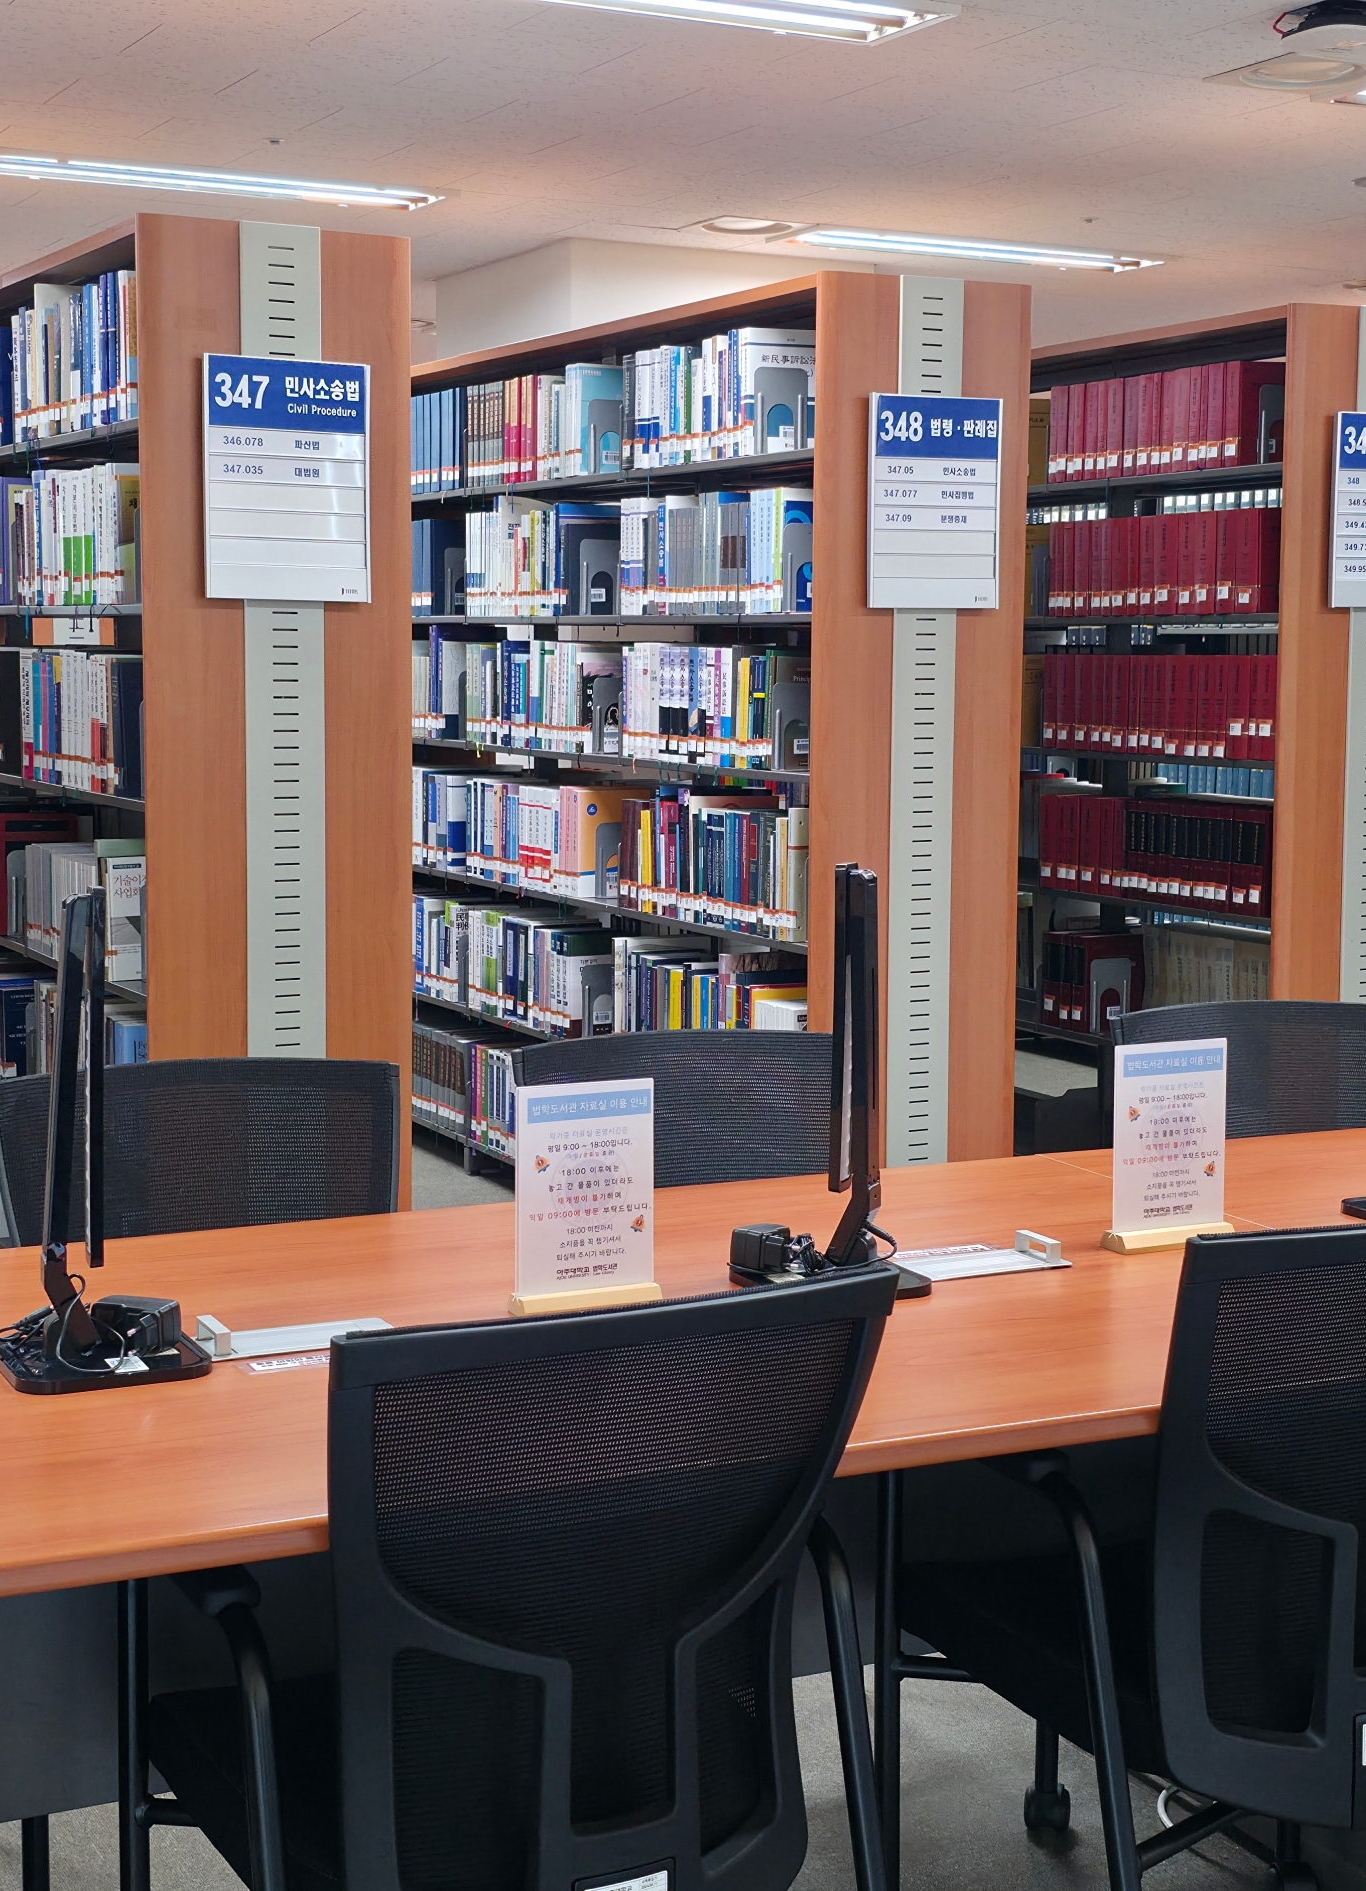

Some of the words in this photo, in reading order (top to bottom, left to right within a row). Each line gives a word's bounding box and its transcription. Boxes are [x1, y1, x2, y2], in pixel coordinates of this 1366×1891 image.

[214, 372, 270, 410] 347
[285, 376, 360, 402] 민사소송법
[288, 403, 308, 415] Civil
[312, 405, 357, 418] Procedure
[880, 410, 923, 442] 348
[223, 435, 264, 447] 346.078
[294, 439, 320, 450] 파산법
[223, 464, 264, 475] 347.035
[294, 467, 320, 478] 대법원
[887, 466, 914, 475] 347.05
[943, 467, 976, 477] 민사소송법
[1347, 477, 1360, 485] 348
[884, 489, 918, 498] 347.077
[885, 514, 912, 523] 347.09
[1344, 565, 1366, 573] 349.95
[1165, 1057, 1188, 1068] 자료실
[1190, 1055, 1204, 1066] 이용
[532, 1103, 577, 1116] 법학도서관
[580, 1100, 607, 1111] 자료실
[610, 1098, 628, 1109] 이용
[630, 1096, 648, 1107] 안내
[548, 1144, 561, 1153] 평일
[563, 1142, 580, 1151] 9:00
[561, 1167, 586, 1176] 18:00
[589, 1165, 620, 1174] 이후에는
[567, 1182, 574, 1191] 간
[577, 1179, 600, 1189] 물품이
[604, 1177, 634, 1187] 있더라도
[529, 1213, 544, 1222] 익일
[547, 1209, 581, 1220] 09:00에
[567, 1226, 586, 1235] 18:00
[560, 1238, 585, 1248] 소지품을
[578, 1250, 597, 1258] 주시기
[556, 1266, 590, 1275] 아주대학교
